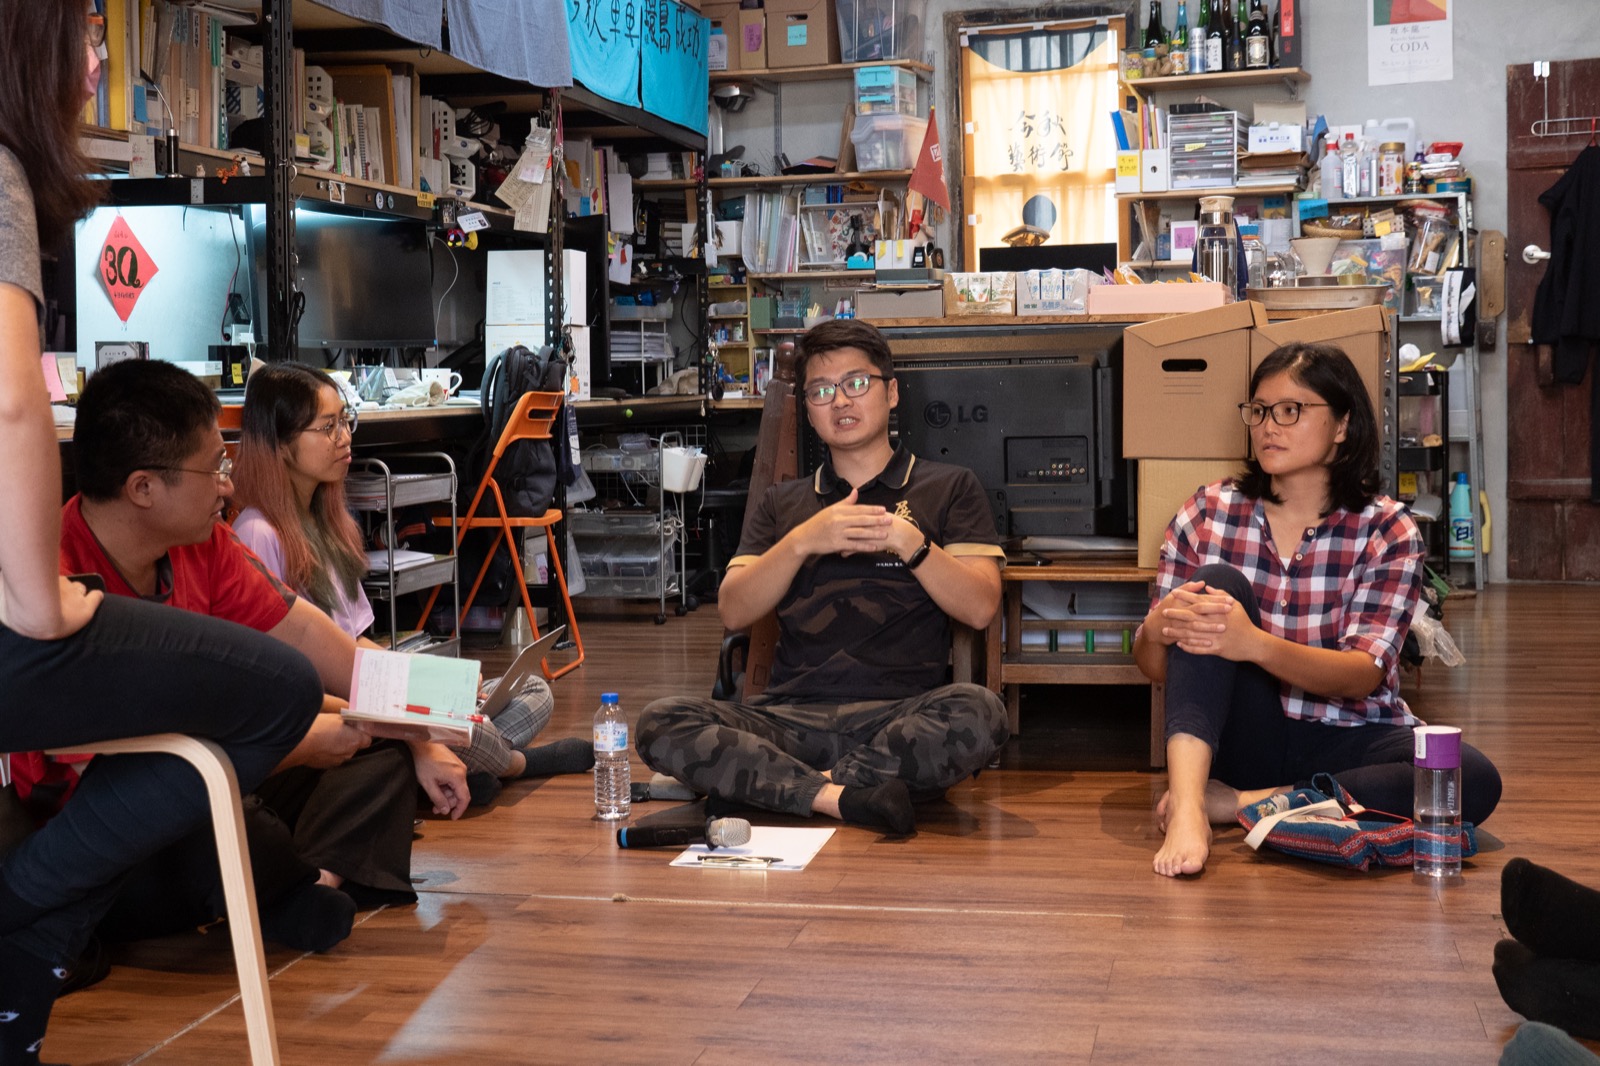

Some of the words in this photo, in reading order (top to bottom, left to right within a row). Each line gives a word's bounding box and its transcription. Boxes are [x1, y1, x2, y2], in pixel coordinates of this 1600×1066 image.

[1390, 41, 1430, 54] CODA
[1008, 142, 1074, 172] 藝術節
[958, 404, 989, 423] LG
[1447, 788, 1455, 810] BRITA
